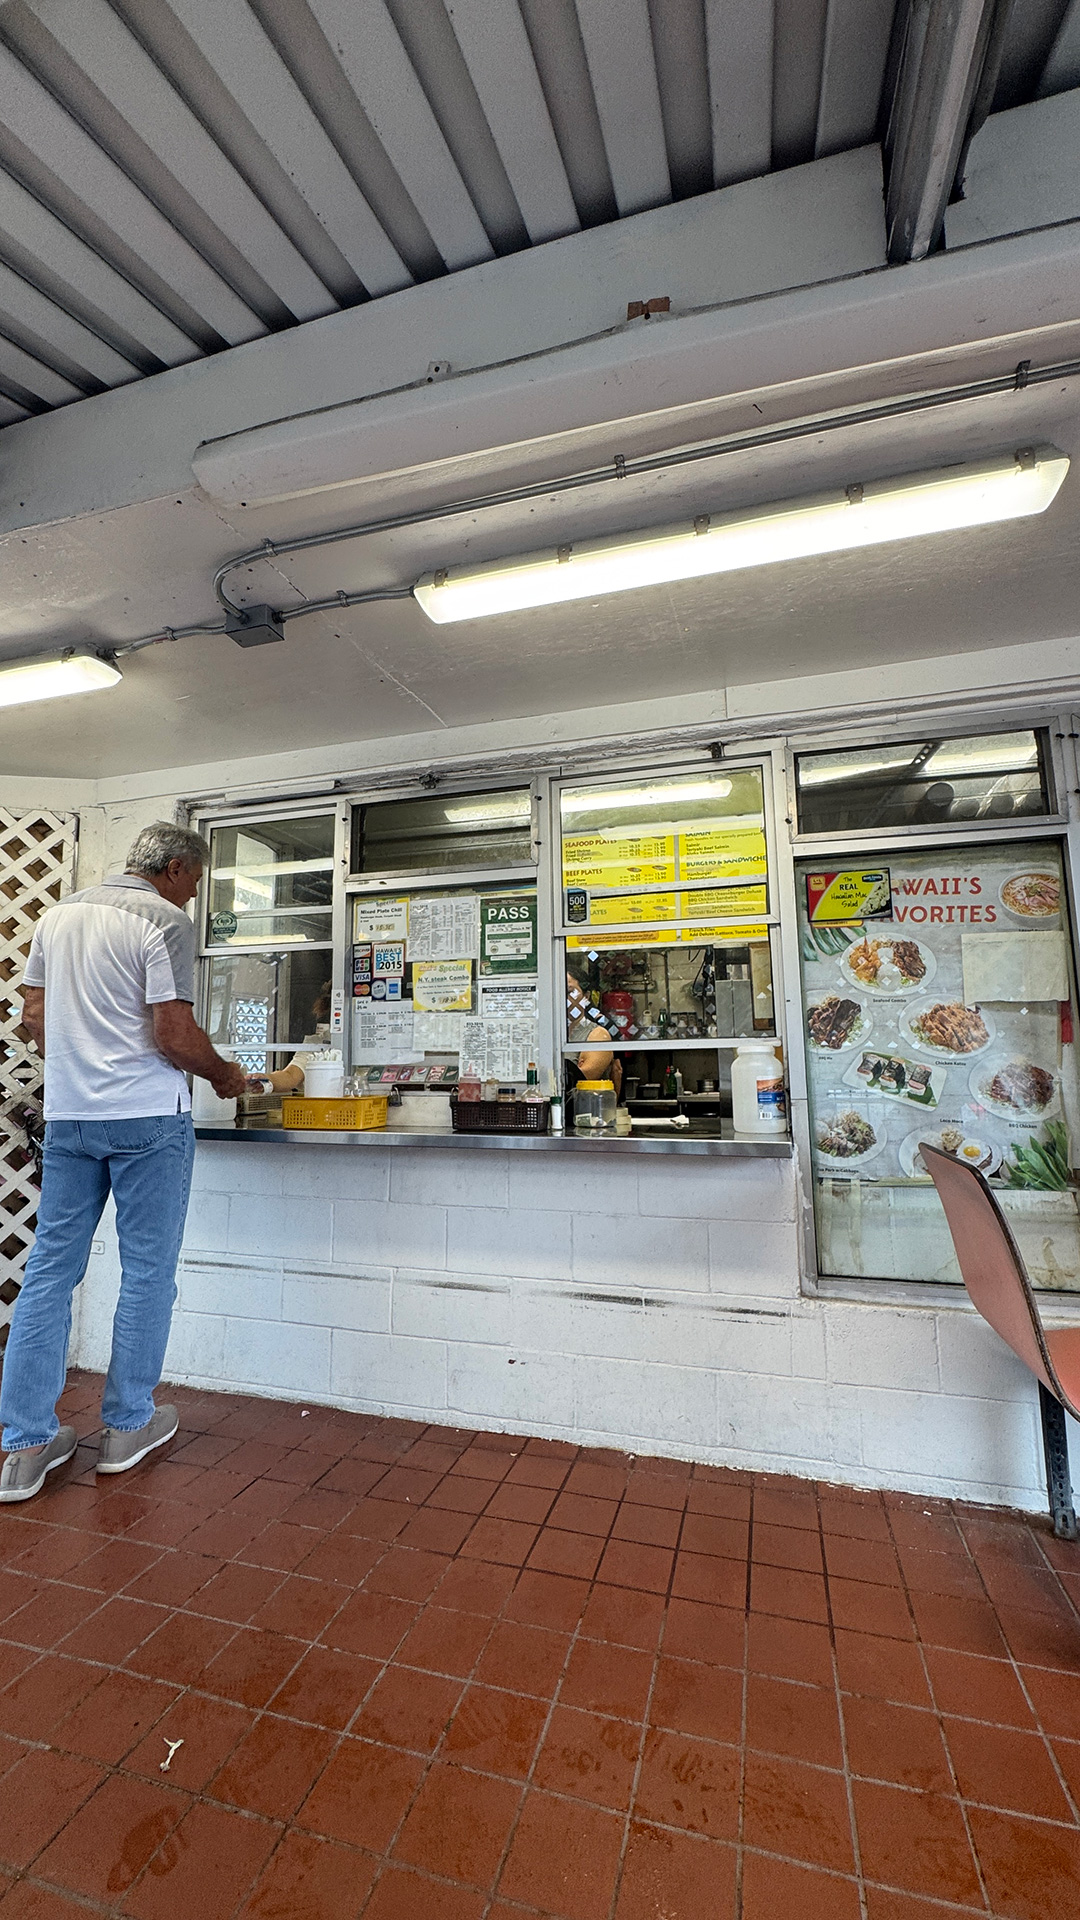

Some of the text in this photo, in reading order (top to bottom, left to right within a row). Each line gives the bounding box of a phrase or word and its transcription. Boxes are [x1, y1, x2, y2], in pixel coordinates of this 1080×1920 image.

[565, 840, 594, 848] SEAFOOD
[723, 856, 767, 865] SANDWICHE
[581, 868, 603, 876] PLATES
[831, 892, 854, 900] Hawaiian
[569, 897, 585, 905] 500
[487, 906, 530, 920] PASS
[375, 952, 402, 962] BEST
[379, 961, 402, 970] 2015
[438, 964, 467, 973] Special
